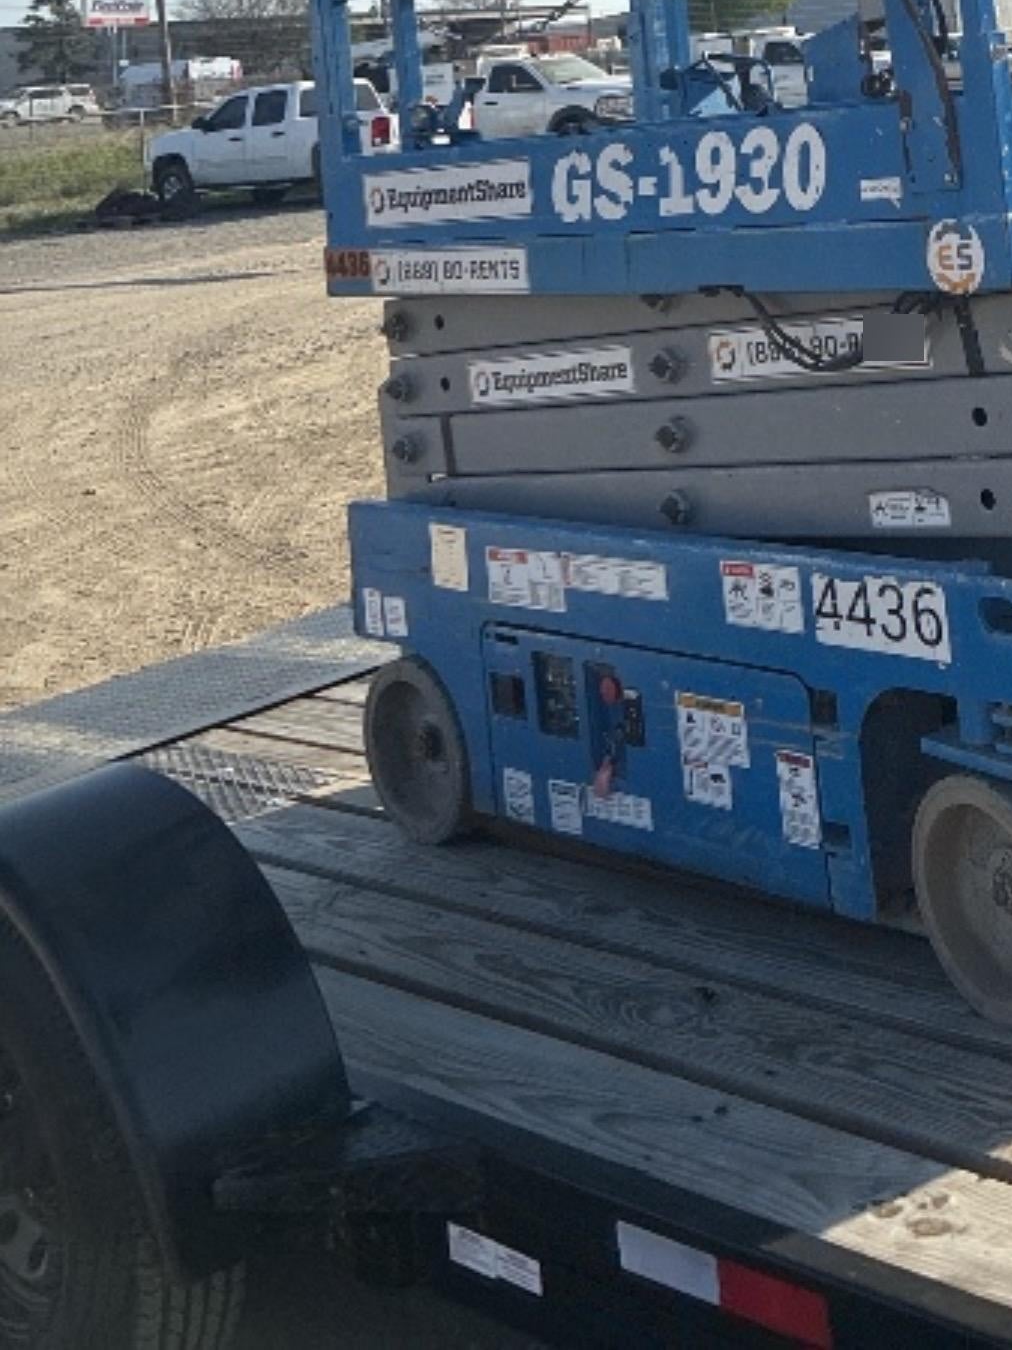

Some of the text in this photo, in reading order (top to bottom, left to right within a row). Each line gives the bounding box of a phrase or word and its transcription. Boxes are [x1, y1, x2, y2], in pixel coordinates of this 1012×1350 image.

[552, 123, 826, 223] GS-1930
[386, 179, 526, 213] EquipmentShare
[938, 243, 973, 271] ES
[491, 362, 628, 393] EquipmentShare
[815, 578, 943, 647] 4436
